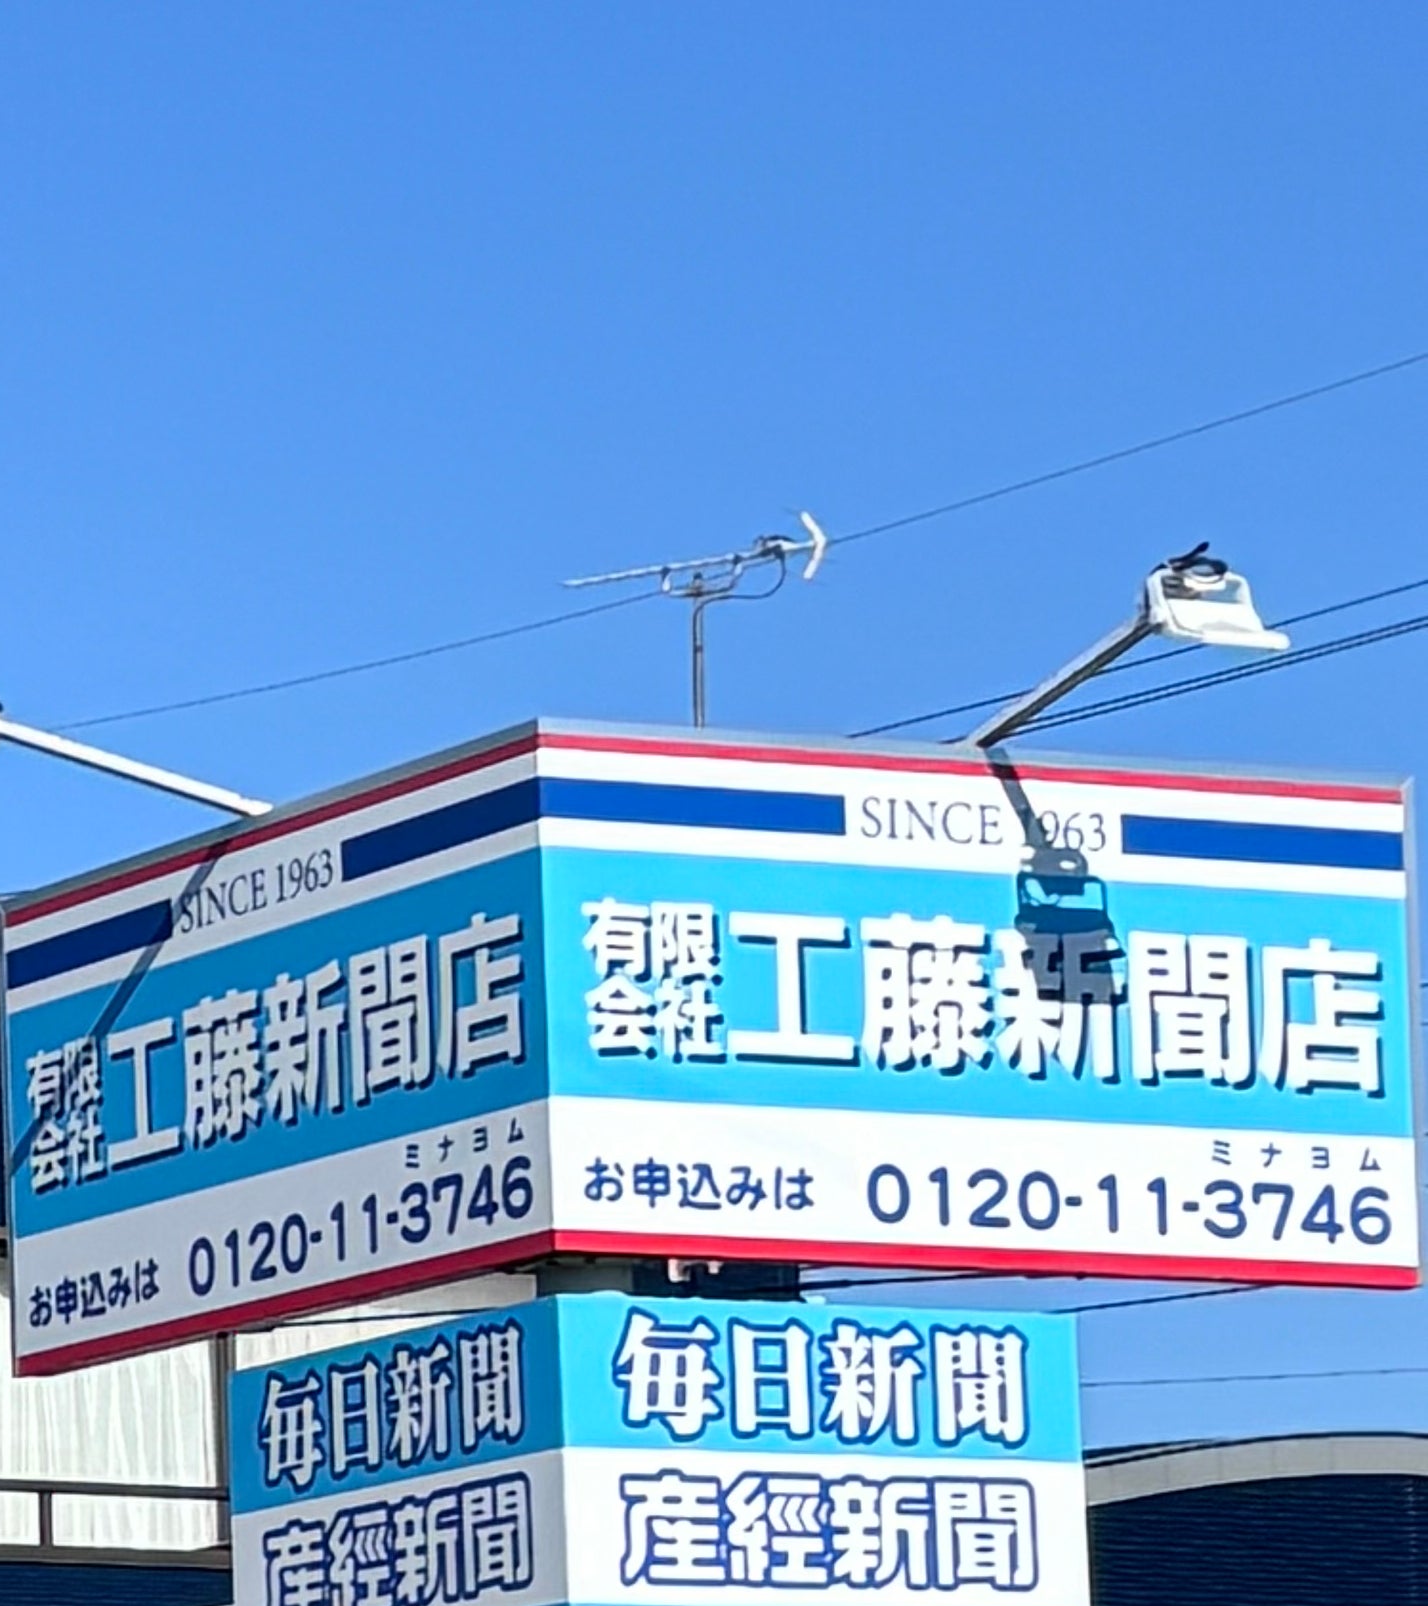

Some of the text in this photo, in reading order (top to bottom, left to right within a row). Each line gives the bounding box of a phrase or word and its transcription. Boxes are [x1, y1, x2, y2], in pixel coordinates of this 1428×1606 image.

[861, 796, 1106, 851] SINCE 963
[181, 849, 334, 933] SINCE 1963
[581, 897, 720, 982] 有限
[107, 912, 526, 1171] 工藤新聞店
[585, 973, 727, 1066] 会社
[728, 909, 1386, 1097] 工藤新聞店
[26, 1035, 103, 1119] 有限
[30, 1104, 108, 1195] 会社
[28, 1156, 534, 1327] お申込みは 0120-11-3746
[582, 1156, 1392, 1245] お申込みは 0120-11-3746
[260, 1317, 524, 1488] 毎日新聞
[612, 1307, 1025, 1446] 毎日新聞
